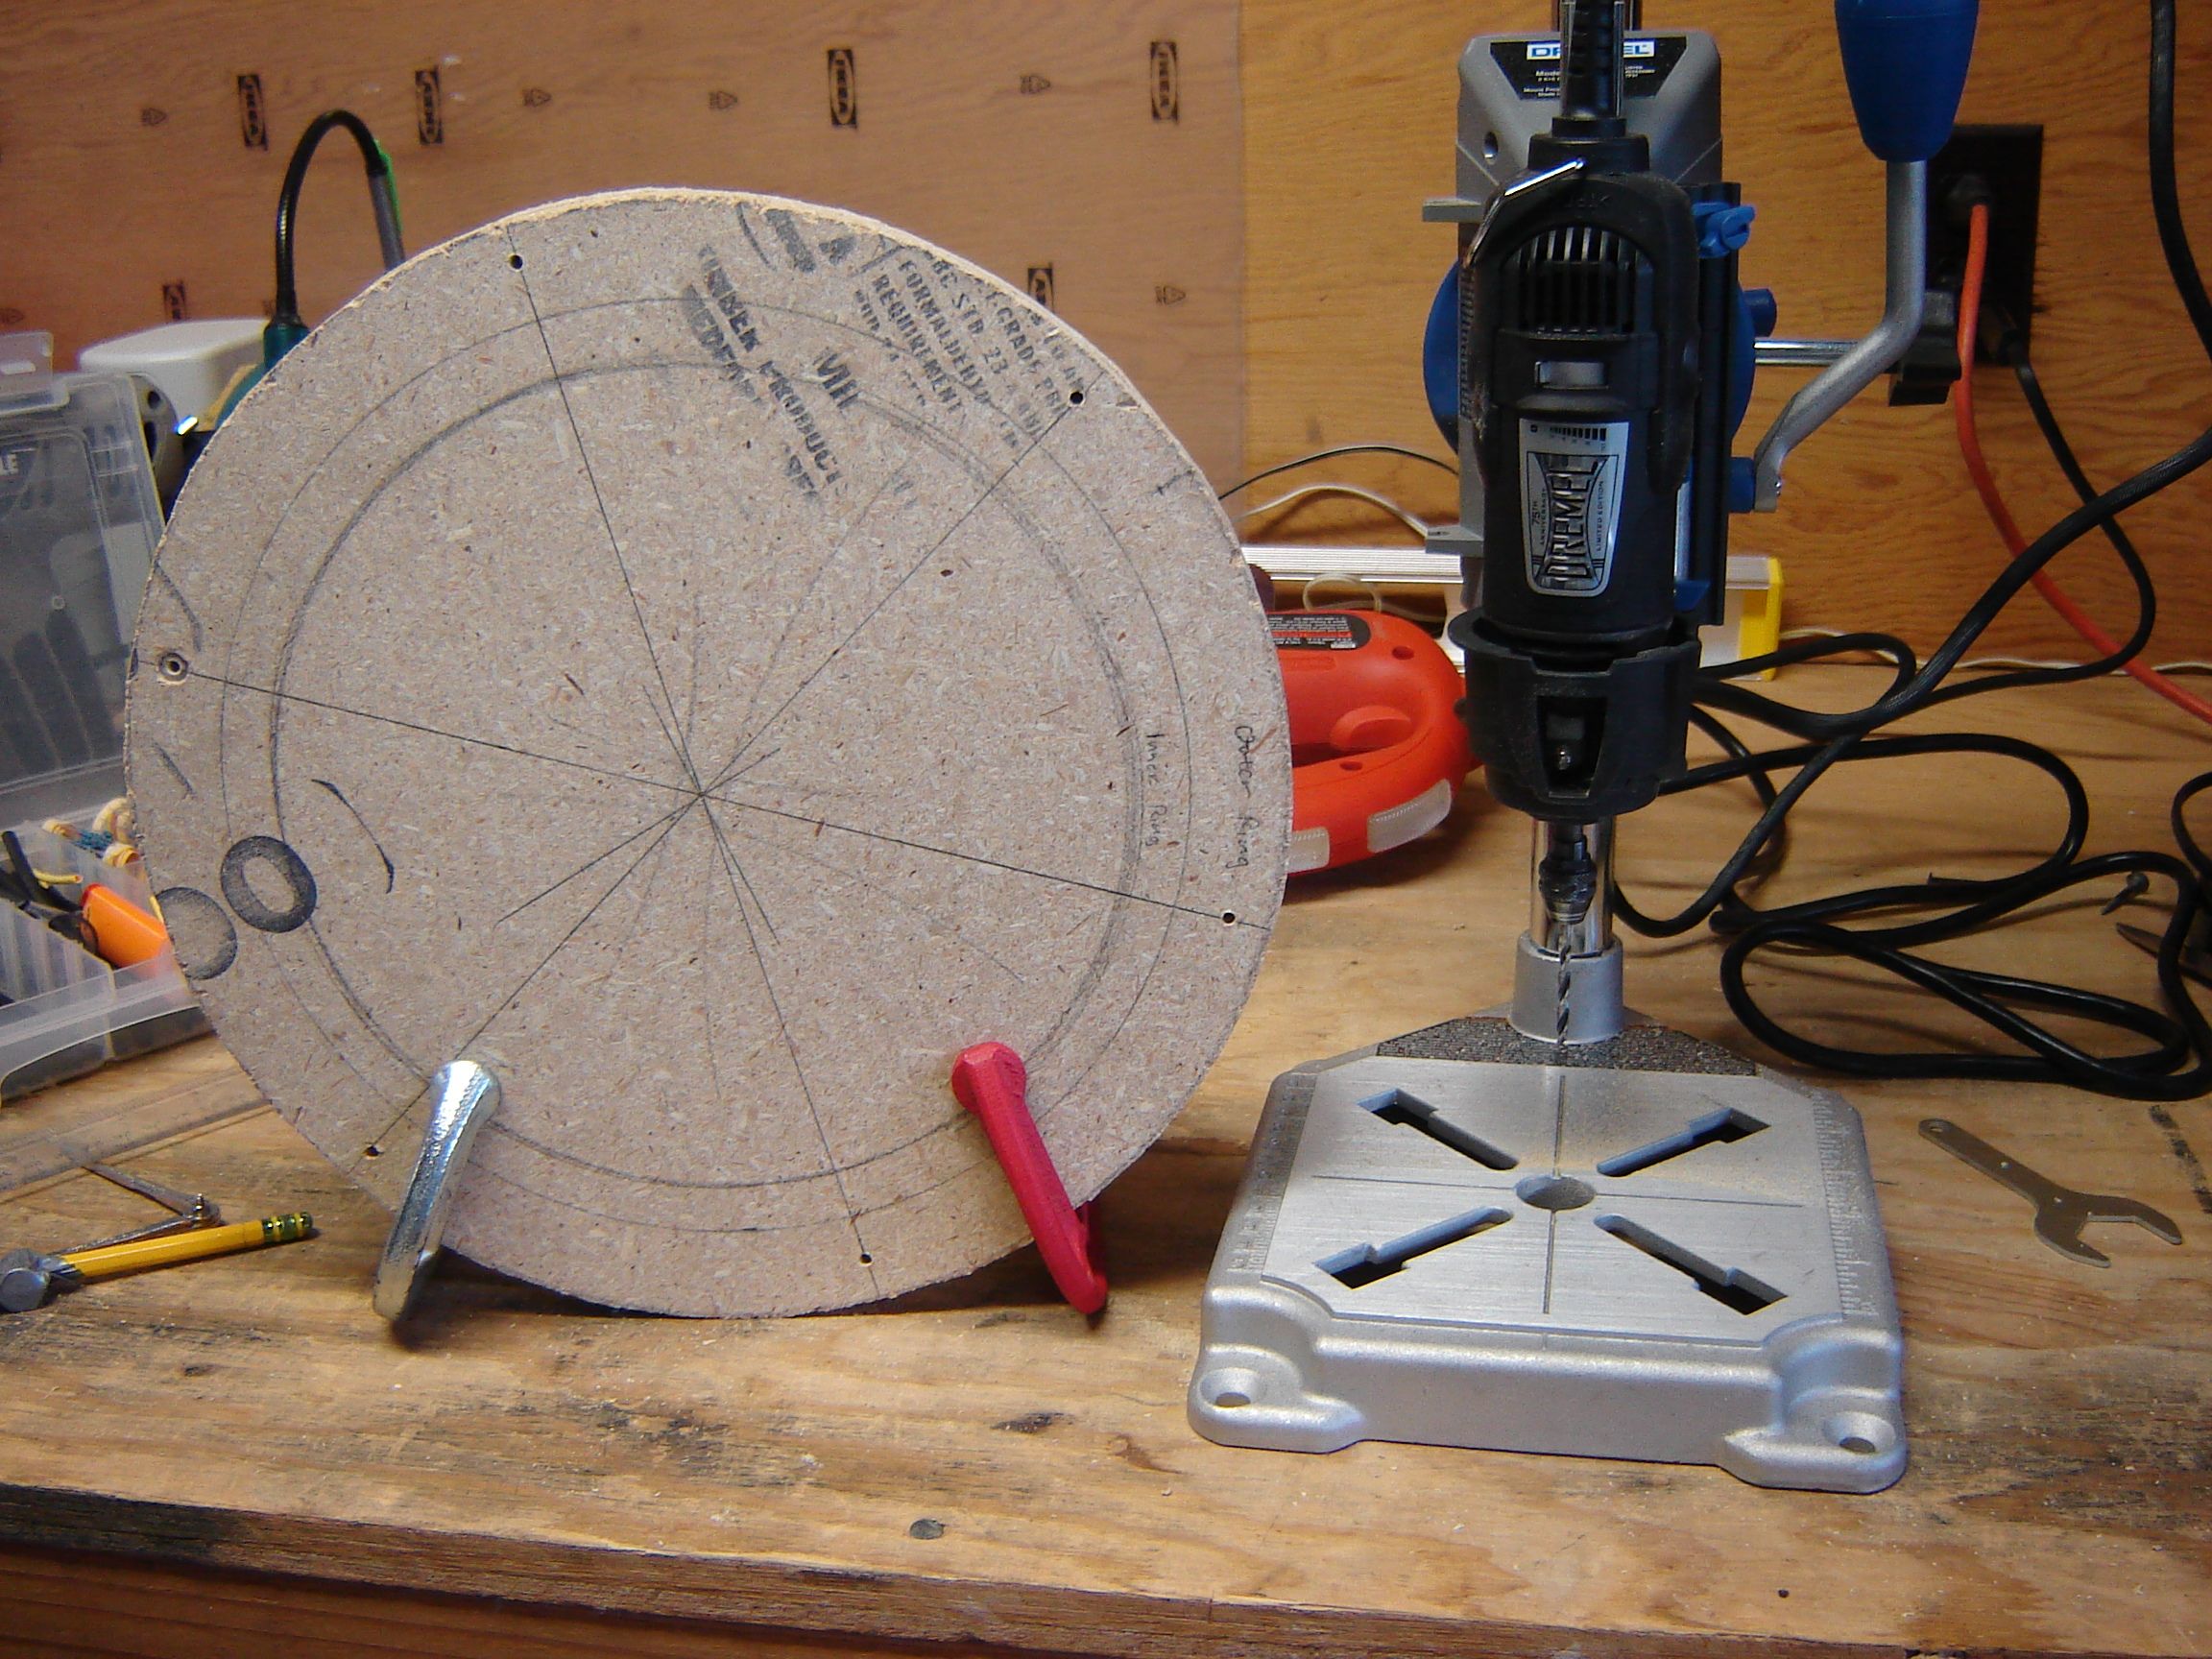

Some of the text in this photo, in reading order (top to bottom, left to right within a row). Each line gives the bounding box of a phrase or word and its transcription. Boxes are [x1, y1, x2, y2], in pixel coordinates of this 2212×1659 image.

[1547, 458, 1599, 578] DREMEL
[1144, 733, 1168, 847] Inner Ring
[1226, 726, 1261, 869] Outer Ring
